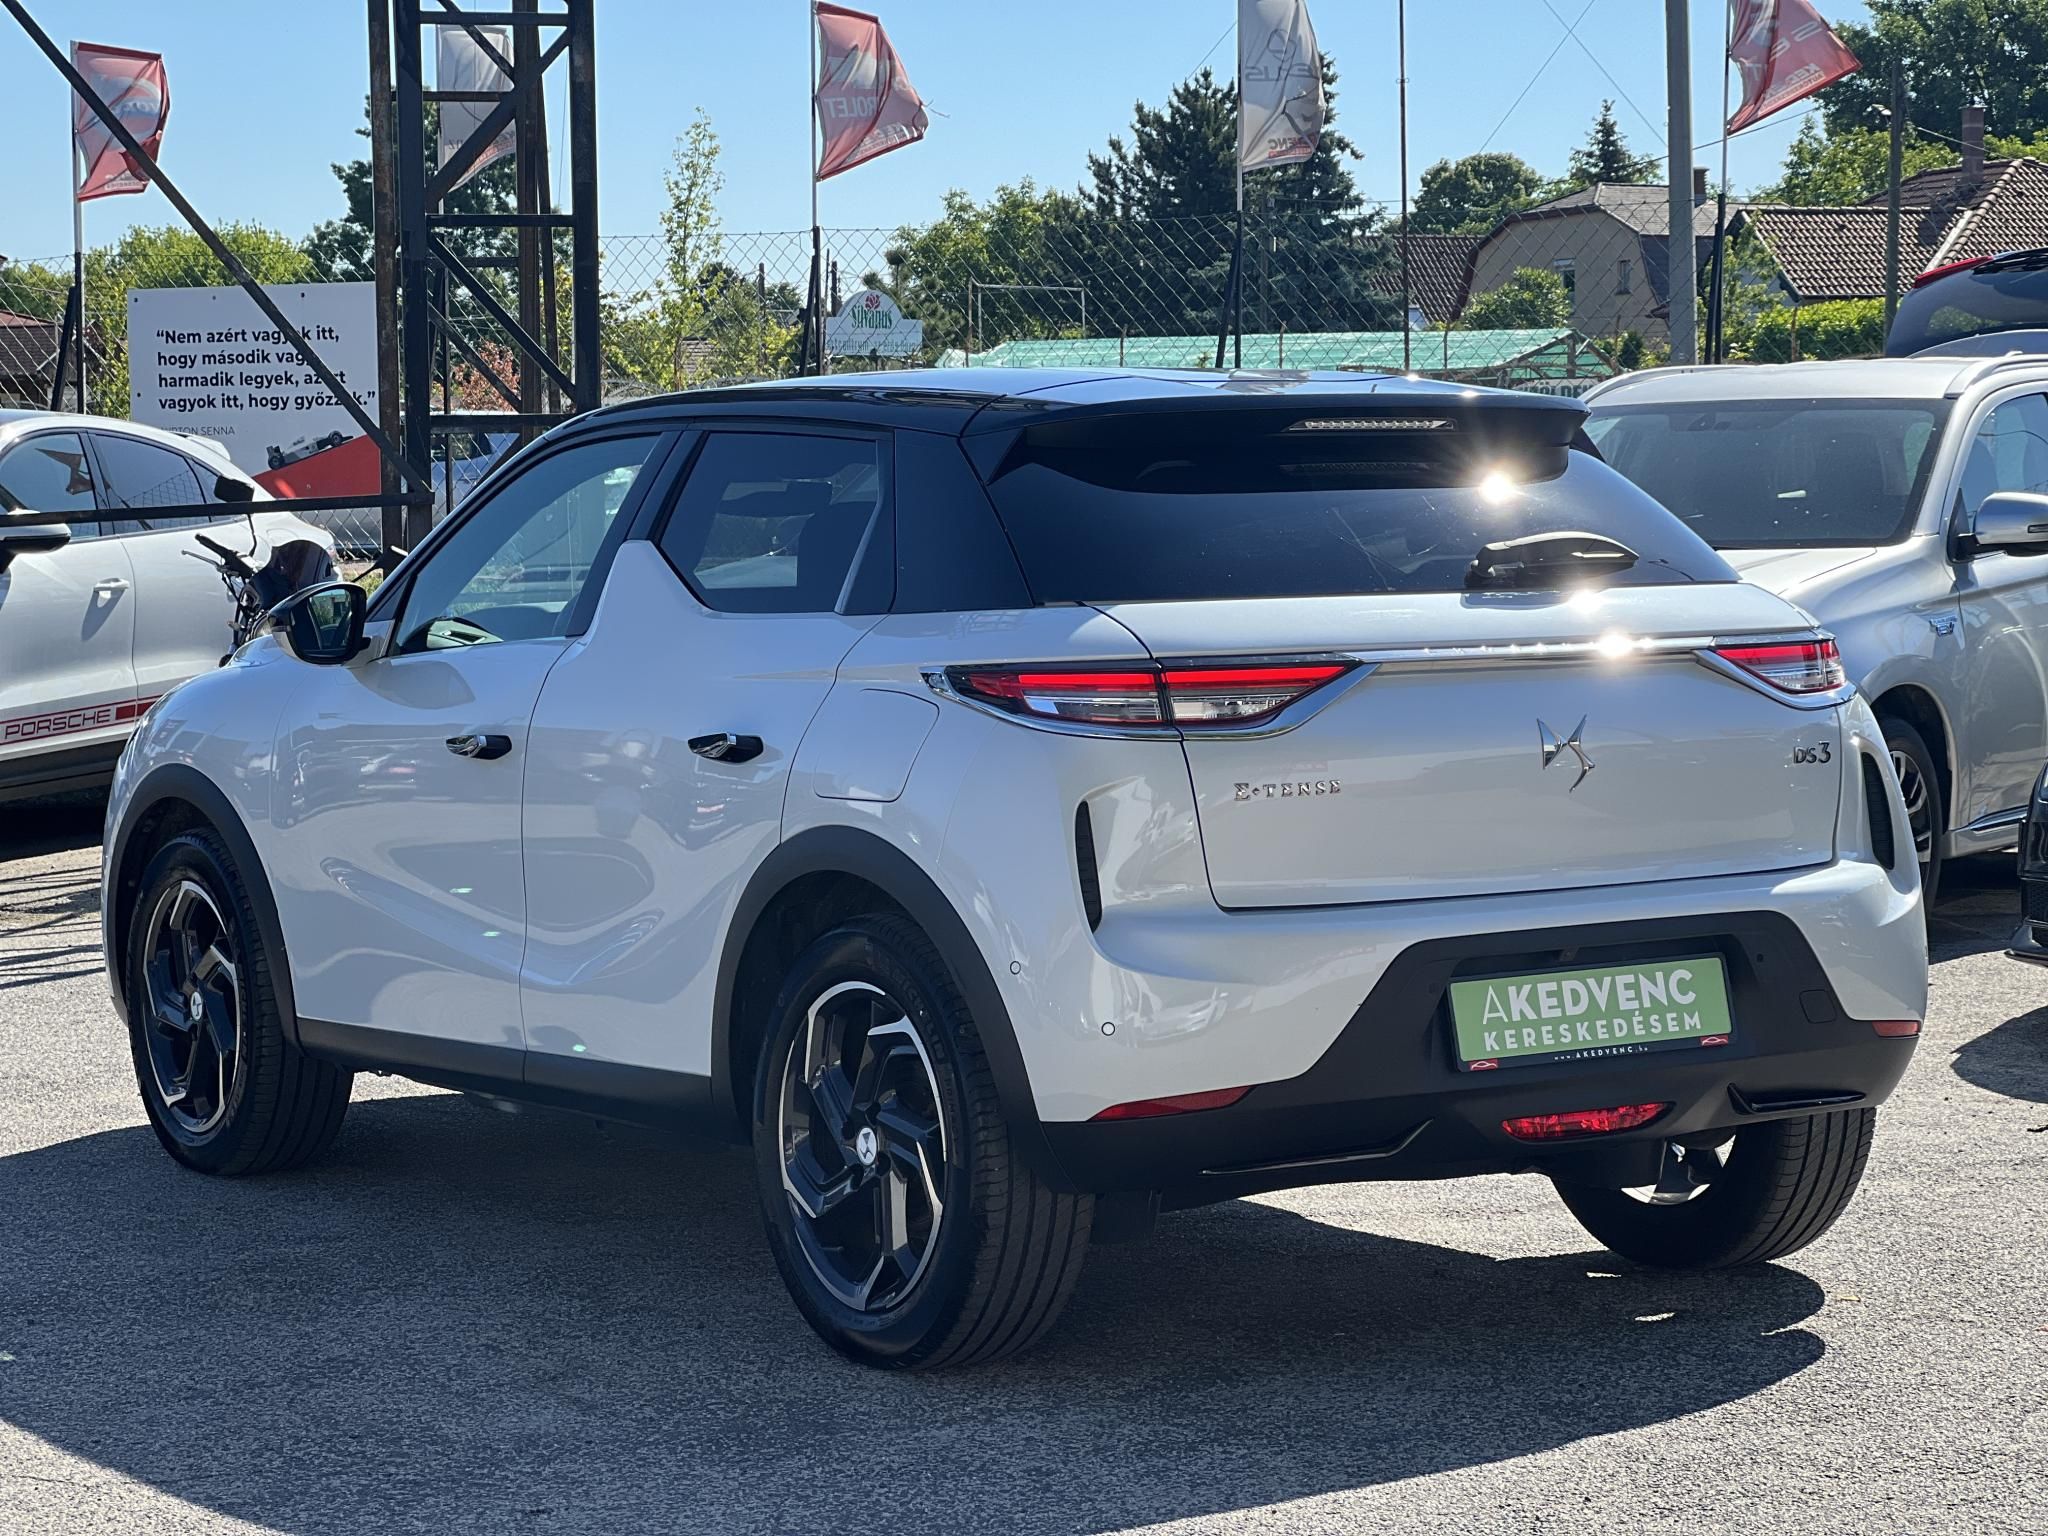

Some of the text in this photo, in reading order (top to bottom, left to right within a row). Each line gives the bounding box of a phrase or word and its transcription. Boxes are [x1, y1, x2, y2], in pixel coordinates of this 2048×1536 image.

[851, 304, 893, 329] Silvanus
[206, 328, 248, 343] azért
[252, 325, 312, 345] vagk
[316, 325, 340, 343] itt,
[157, 350, 310, 369] hogy második vag
[158, 371, 347, 390] harmadik legyek, azt
[159, 394, 217, 413] vagyok
[221, 393, 244, 410] itt,
[248, 393, 290, 411] hogy
[200, 425, 236, 436] SENNA
[5, 709, 111, 739] PORSCHE
[1484, 1010, 1702, 1052] KERESKEDÉSEM
